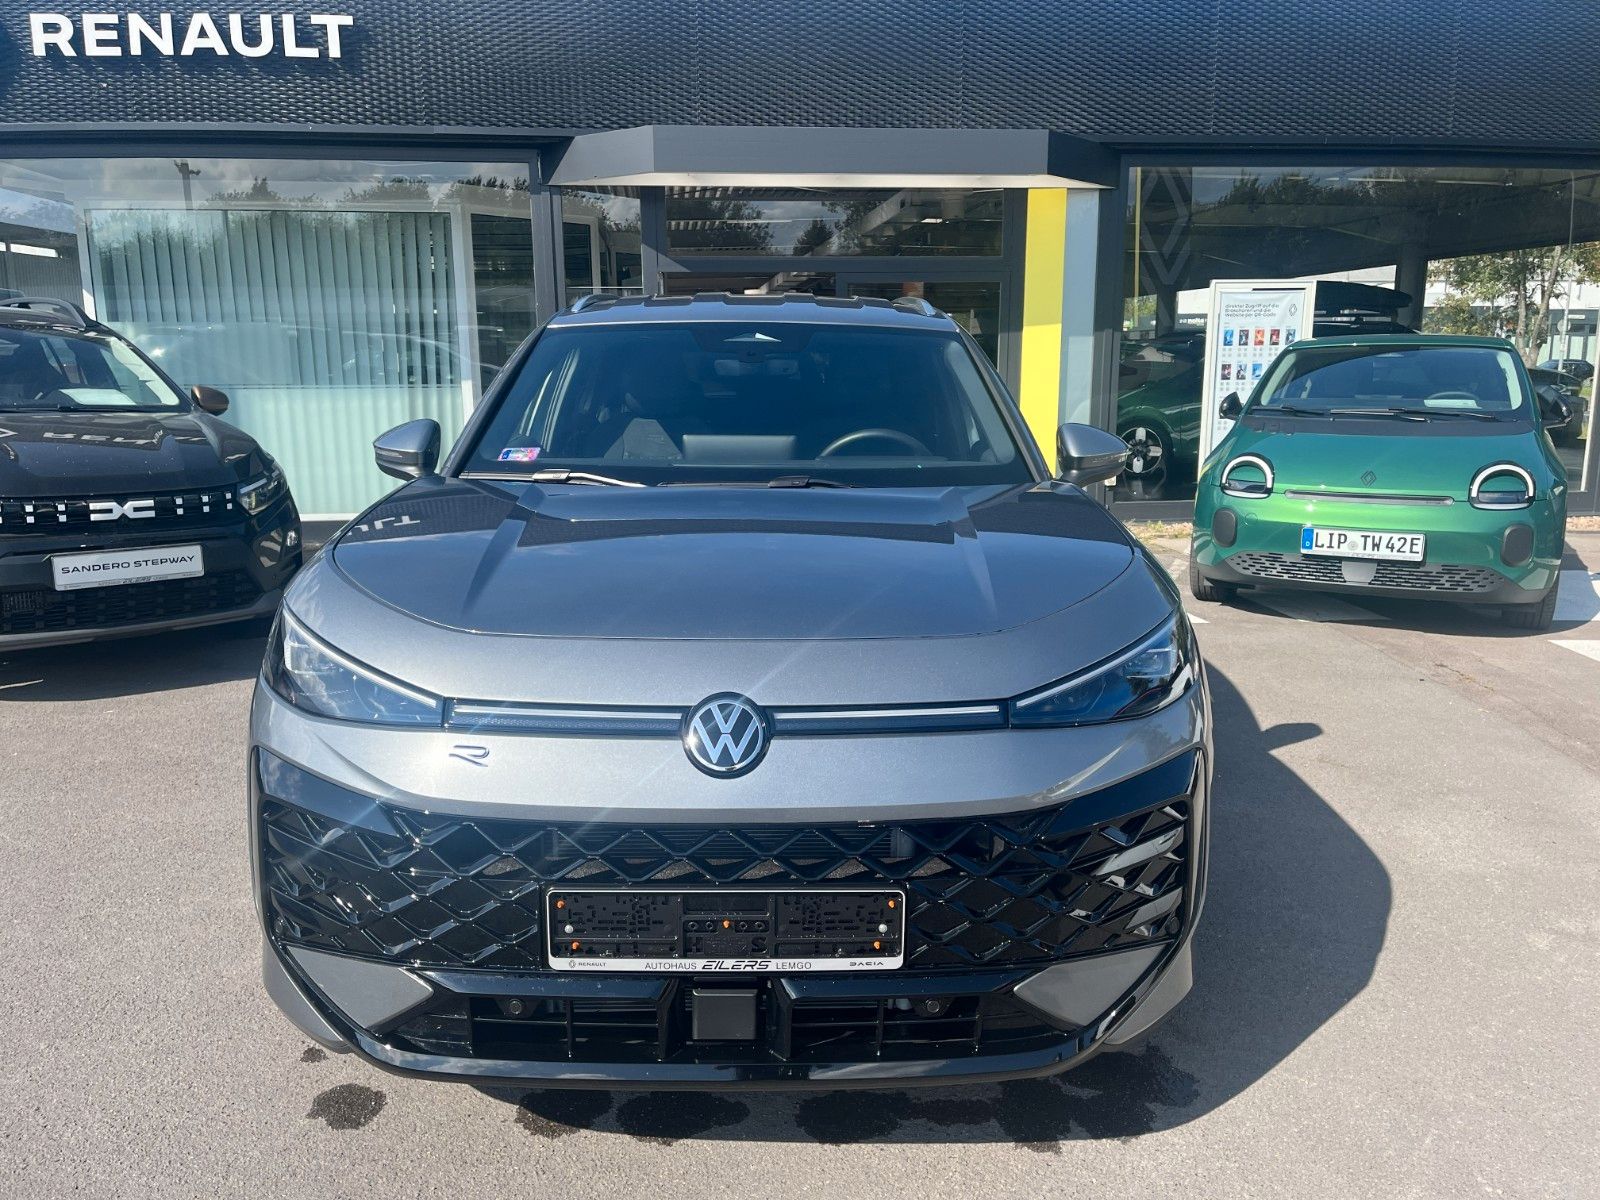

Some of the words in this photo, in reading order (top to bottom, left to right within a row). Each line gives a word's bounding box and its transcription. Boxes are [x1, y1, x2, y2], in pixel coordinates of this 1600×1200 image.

[29, 12, 354, 59] RENAULT
[1314, 531, 1348, 549] LIP
[1361, 535, 1383, 552] TW
[1385, 536, 1421, 554] 42E
[61, 562, 131, 574] SANDERO
[133, 555, 195, 567] STEPWAY
[644, 962, 697, 970] AUTOHAUS
[702, 960, 772, 970] EILERS
[775, 962, 812, 970] LEMGO
